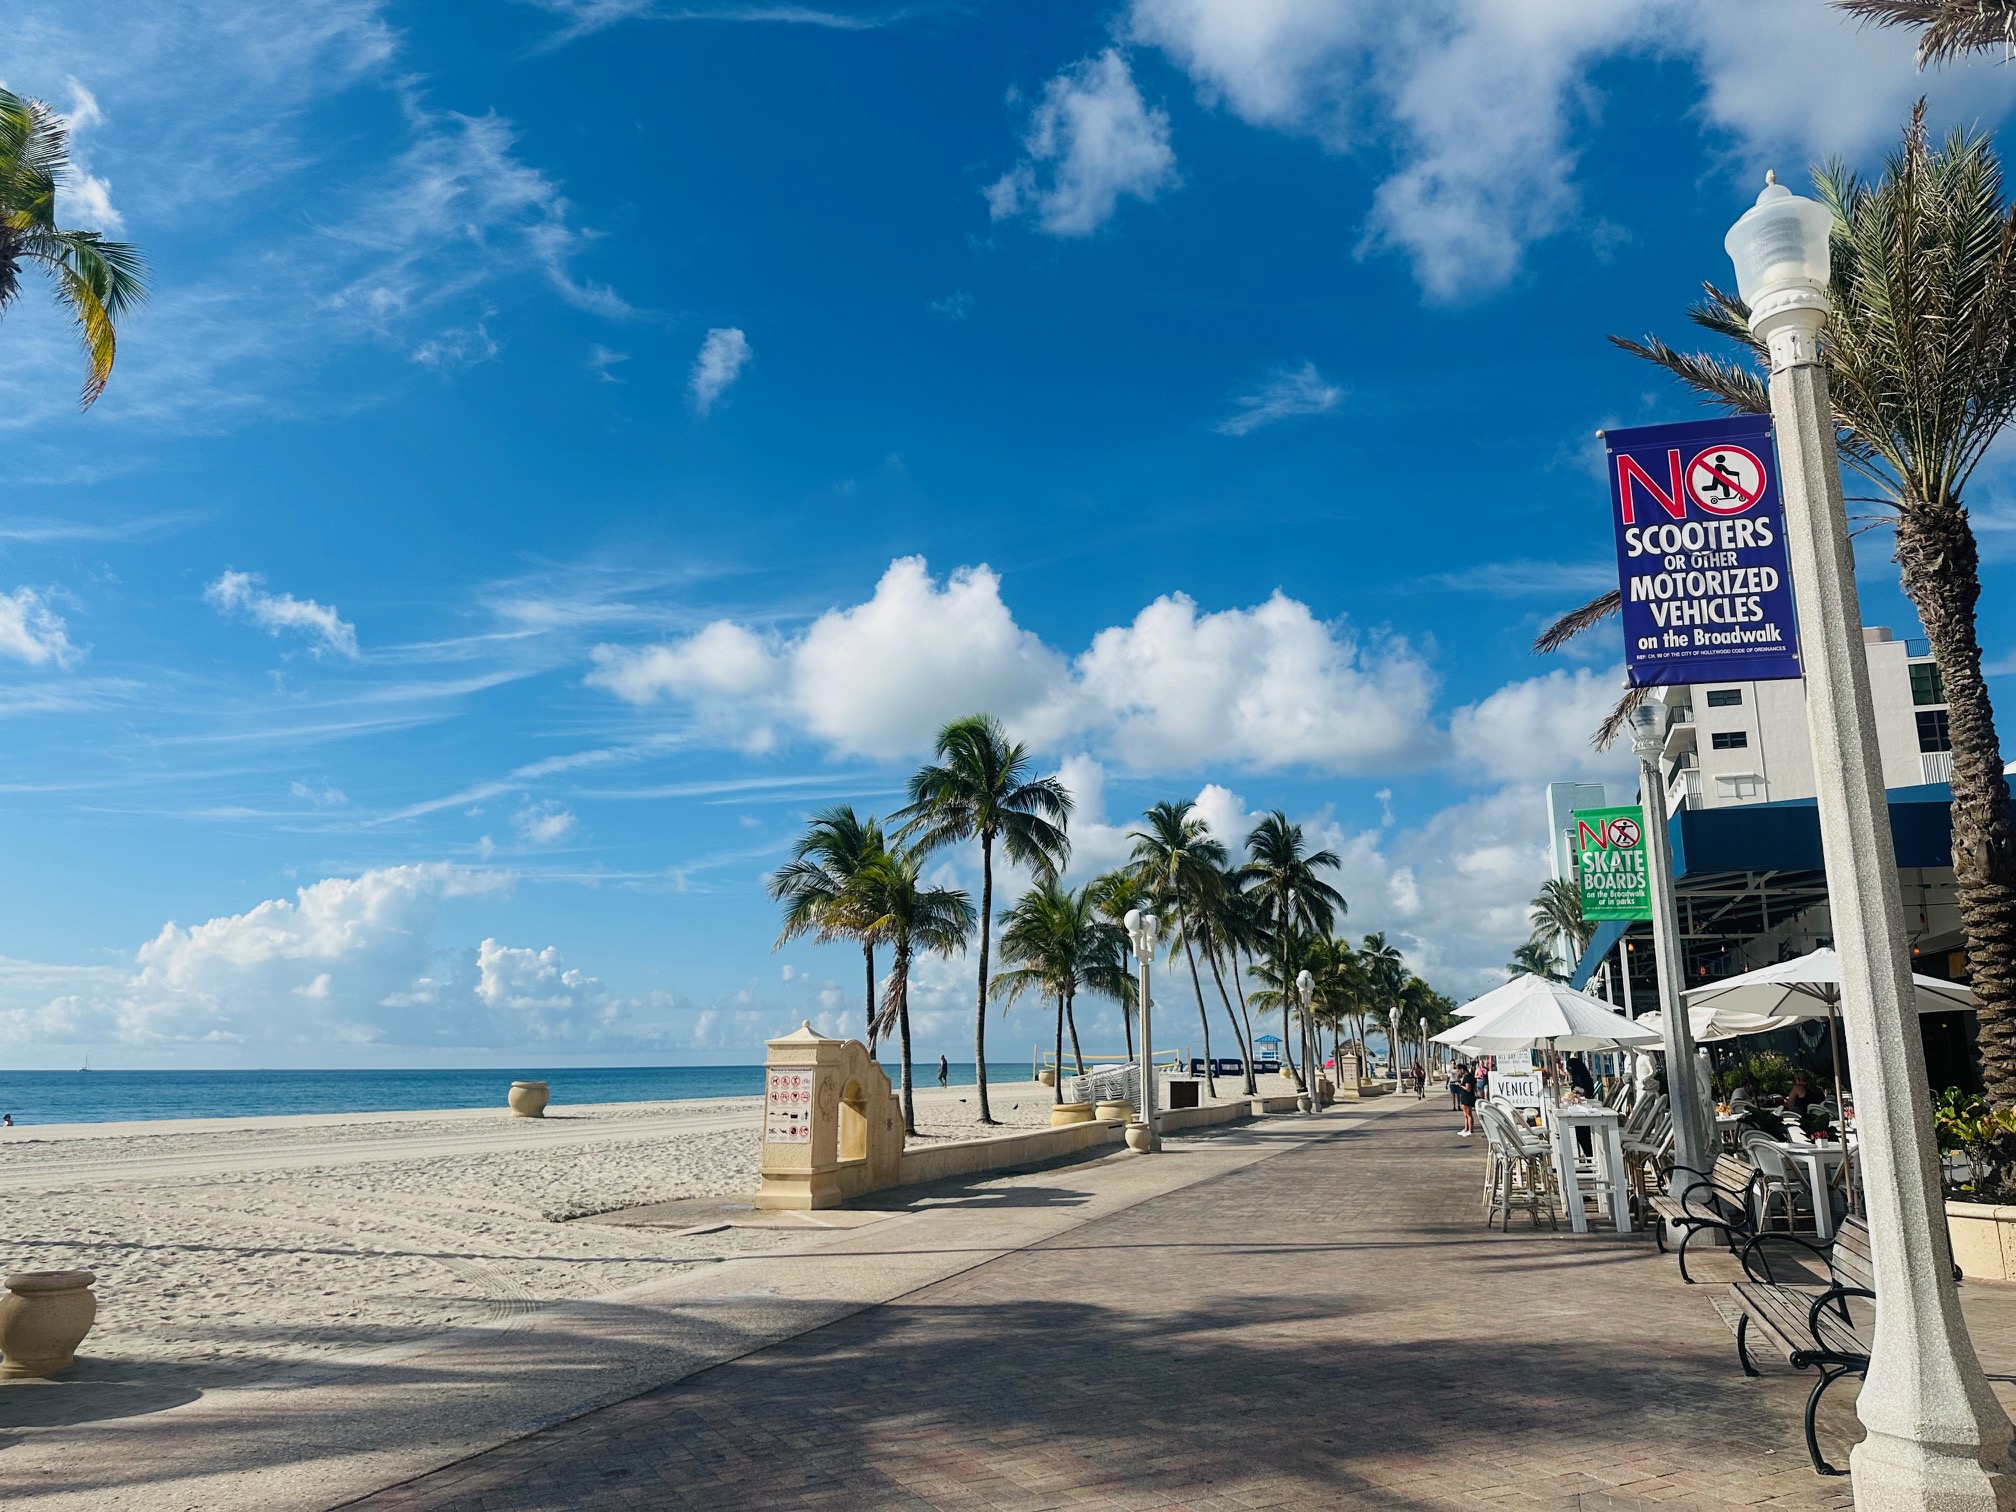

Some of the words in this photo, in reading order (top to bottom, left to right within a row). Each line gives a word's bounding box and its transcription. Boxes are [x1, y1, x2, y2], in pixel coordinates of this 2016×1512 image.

[1625, 517, 1773, 557] SCOOTERS
[1664, 554, 1686, 571] OR
[1690, 551, 1738, 568] OTHER
[1631, 567, 1779, 602] MOTORIZED
[1649, 596, 1764, 627] VEHICLES
[1638, 633, 1658, 650] on
[1663, 629, 1689, 647] the
[1694, 623, 1782, 647] Broadwalk
[1582, 850, 1645, 873] SKATE
[1584, 872, 1646, 890] BOARDS
[1610, 889, 1646, 898] Broadwalk
[1617, 898, 1635, 906] parks
[1498, 1082, 1534, 1096] VENICE
